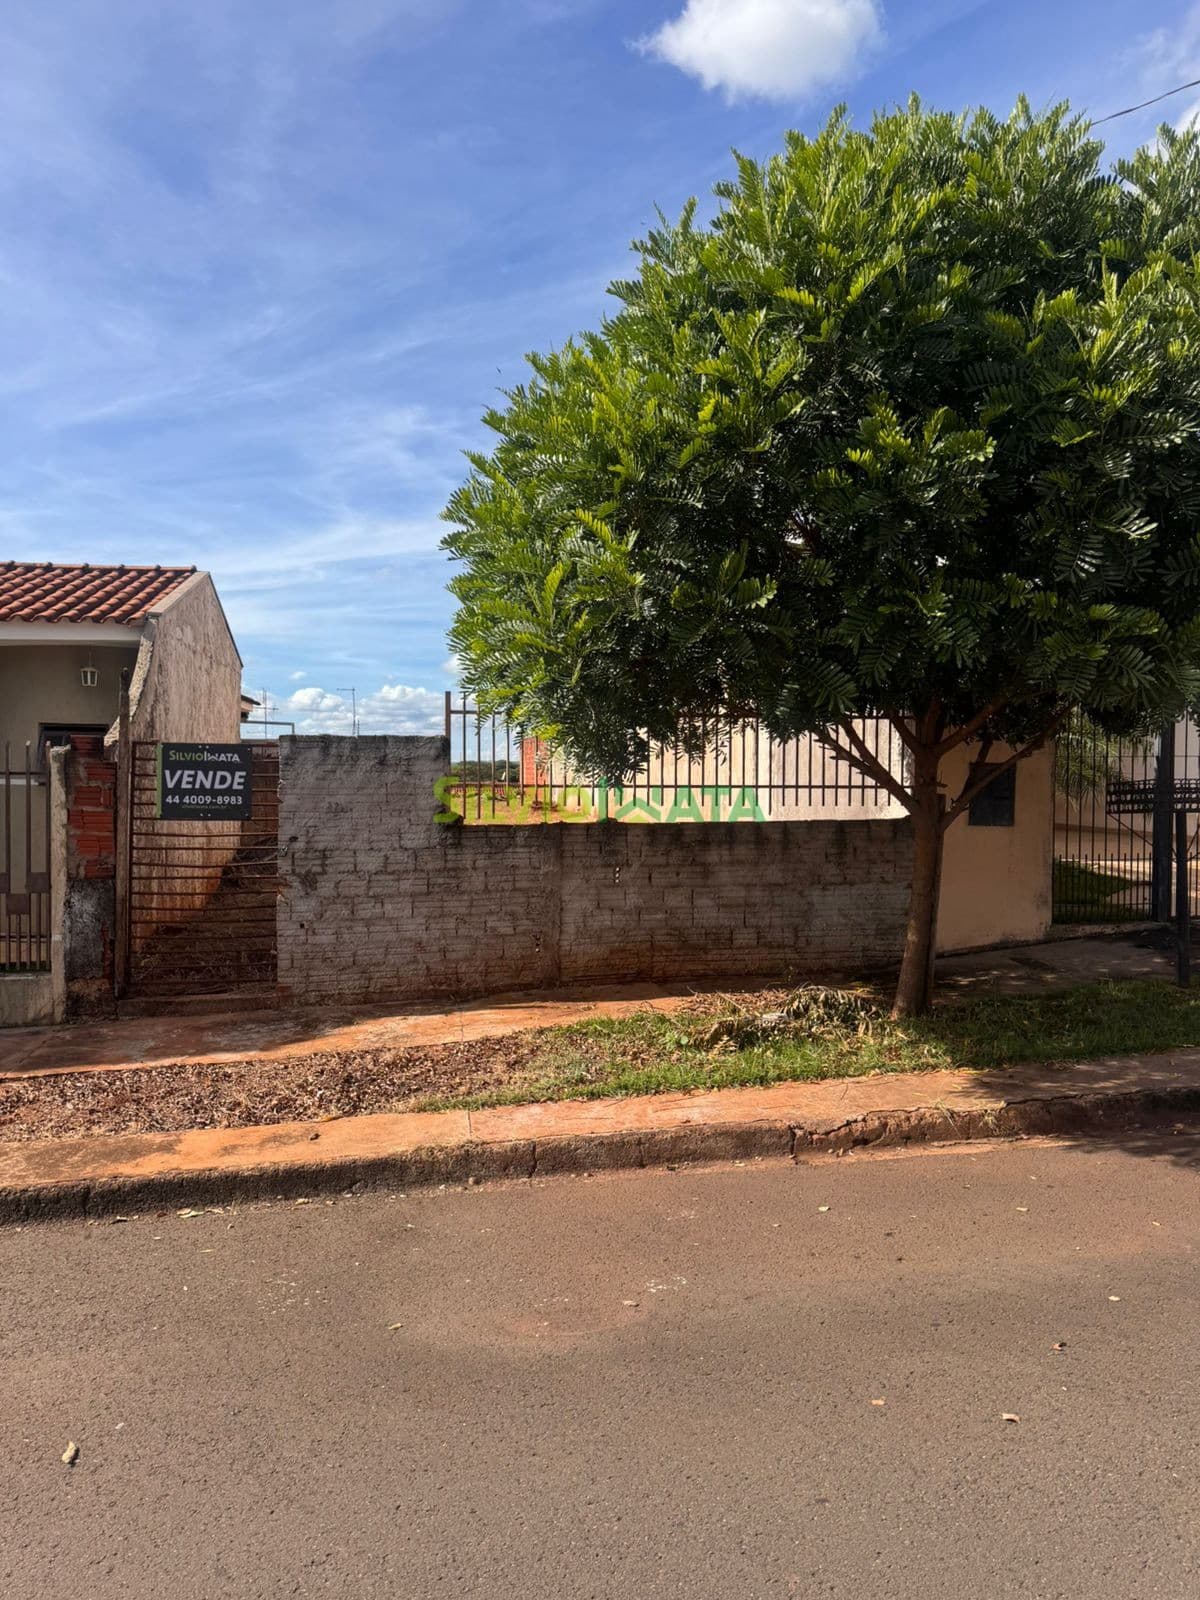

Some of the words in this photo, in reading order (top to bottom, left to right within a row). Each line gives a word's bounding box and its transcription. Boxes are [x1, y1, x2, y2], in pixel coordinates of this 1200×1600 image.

[164, 769, 247, 790] VENDE
[165, 795, 179, 804] 44
[182, 795, 242, 805] 4009-8983
